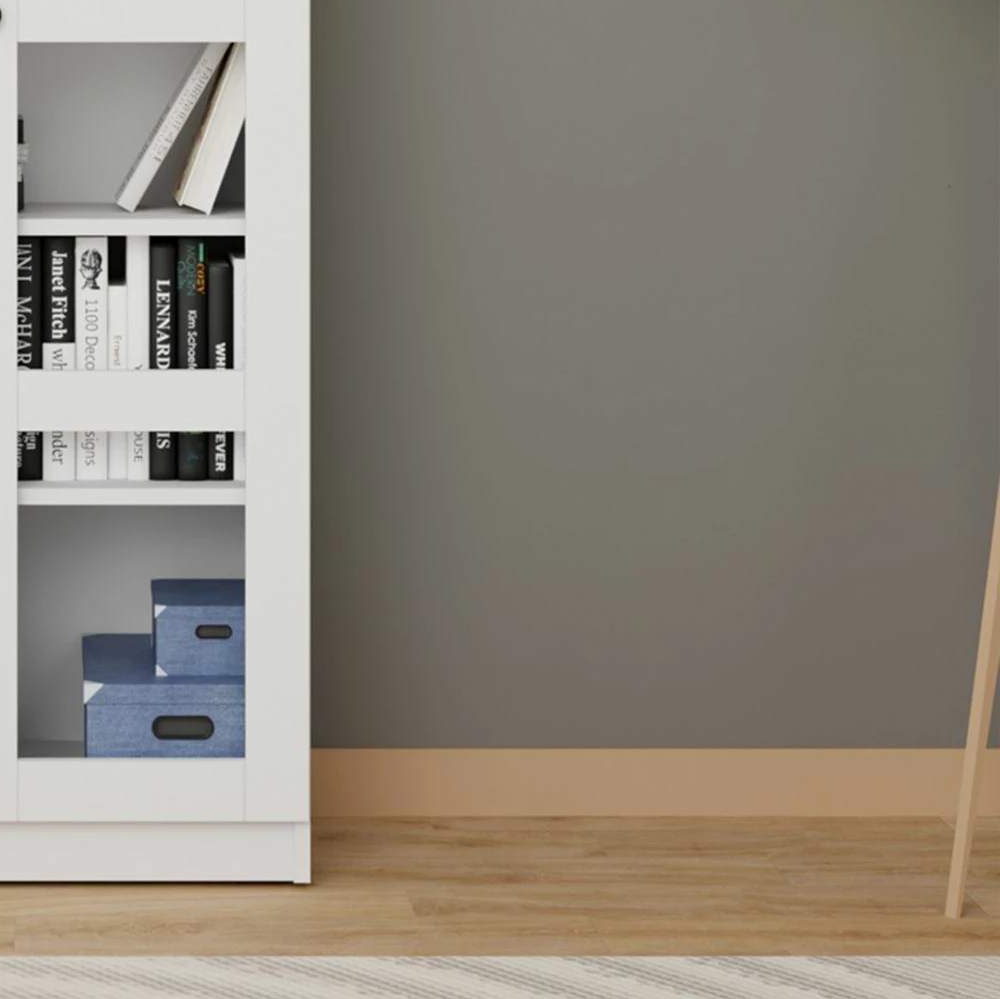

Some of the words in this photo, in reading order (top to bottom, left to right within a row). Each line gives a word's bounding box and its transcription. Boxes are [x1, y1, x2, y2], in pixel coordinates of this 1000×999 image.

[52, 250, 68, 292] Janet
[52, 295, 68, 339] Fitch
[85, 299, 99, 331] 1100
[156, 279, 171, 370] LENNARD
[188, 309, 197, 329] Kim
[24, 432, 40, 450] ign
[81, 431, 99, 466] signs
[215, 431, 226, 472] EVER
